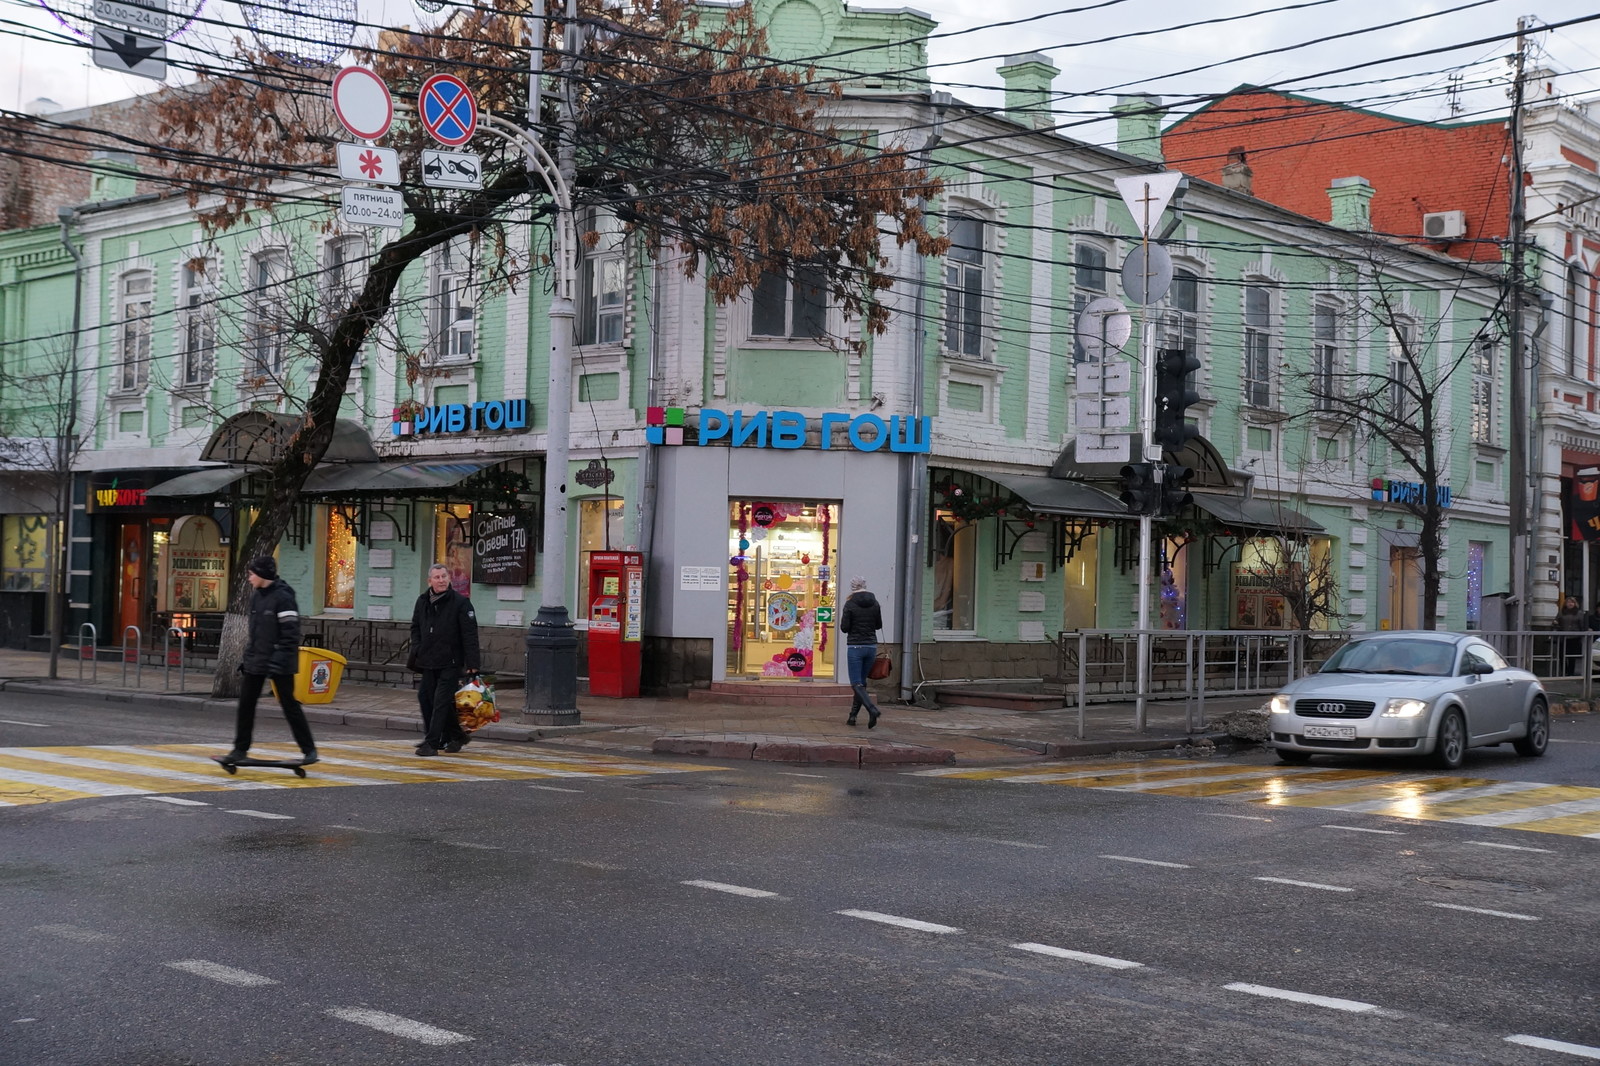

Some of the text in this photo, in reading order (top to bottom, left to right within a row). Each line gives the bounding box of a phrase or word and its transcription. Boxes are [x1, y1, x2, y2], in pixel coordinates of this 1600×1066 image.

[353, 193, 394, 205] пятница
[346, 204, 402, 220] 20.00-24.00
[414, 399, 526, 435] РИВ ГОШ
[698, 408, 931, 453] РИВ ГОШ
[511, 527, 526, 549] 170
